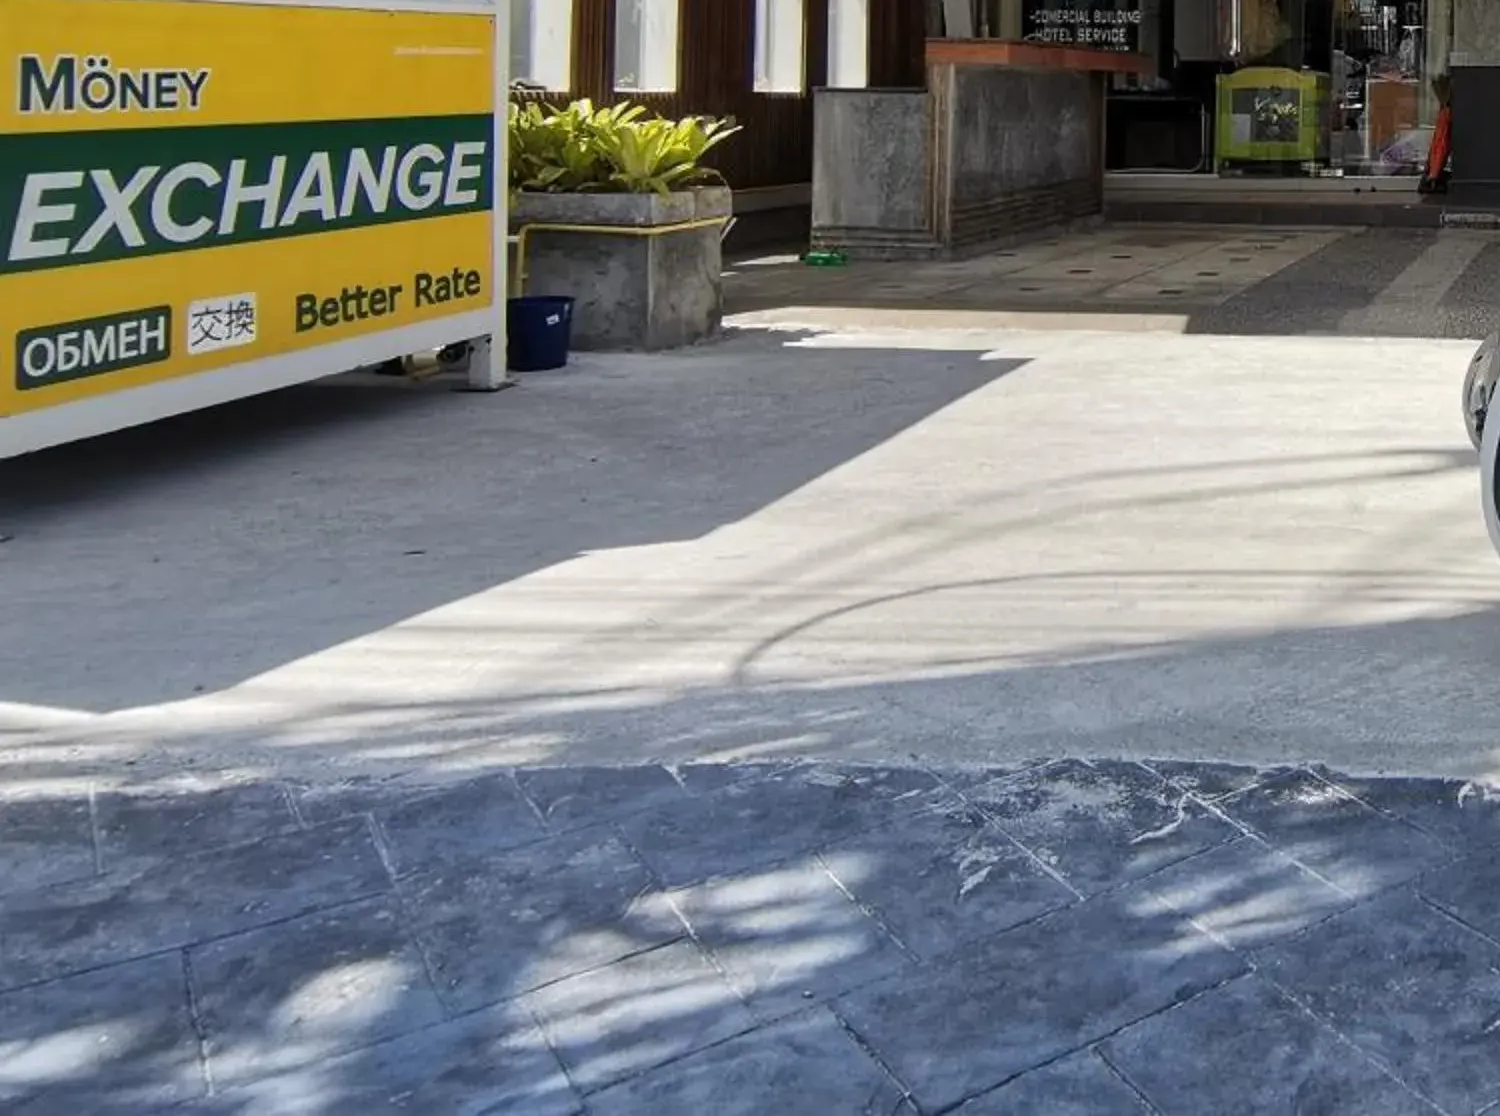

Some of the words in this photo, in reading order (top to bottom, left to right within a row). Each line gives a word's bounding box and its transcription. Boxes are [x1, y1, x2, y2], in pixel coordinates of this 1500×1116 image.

[1077, 27, 1127, 43] SERVICE
[18, 55, 209, 112] MÖNEY
[8, 141, 486, 263] EXCHANGE
[296, 284, 404, 334] Better
[415, 266, 481, 309] Rate
[22, 315, 166, 378] ОБМЕН
